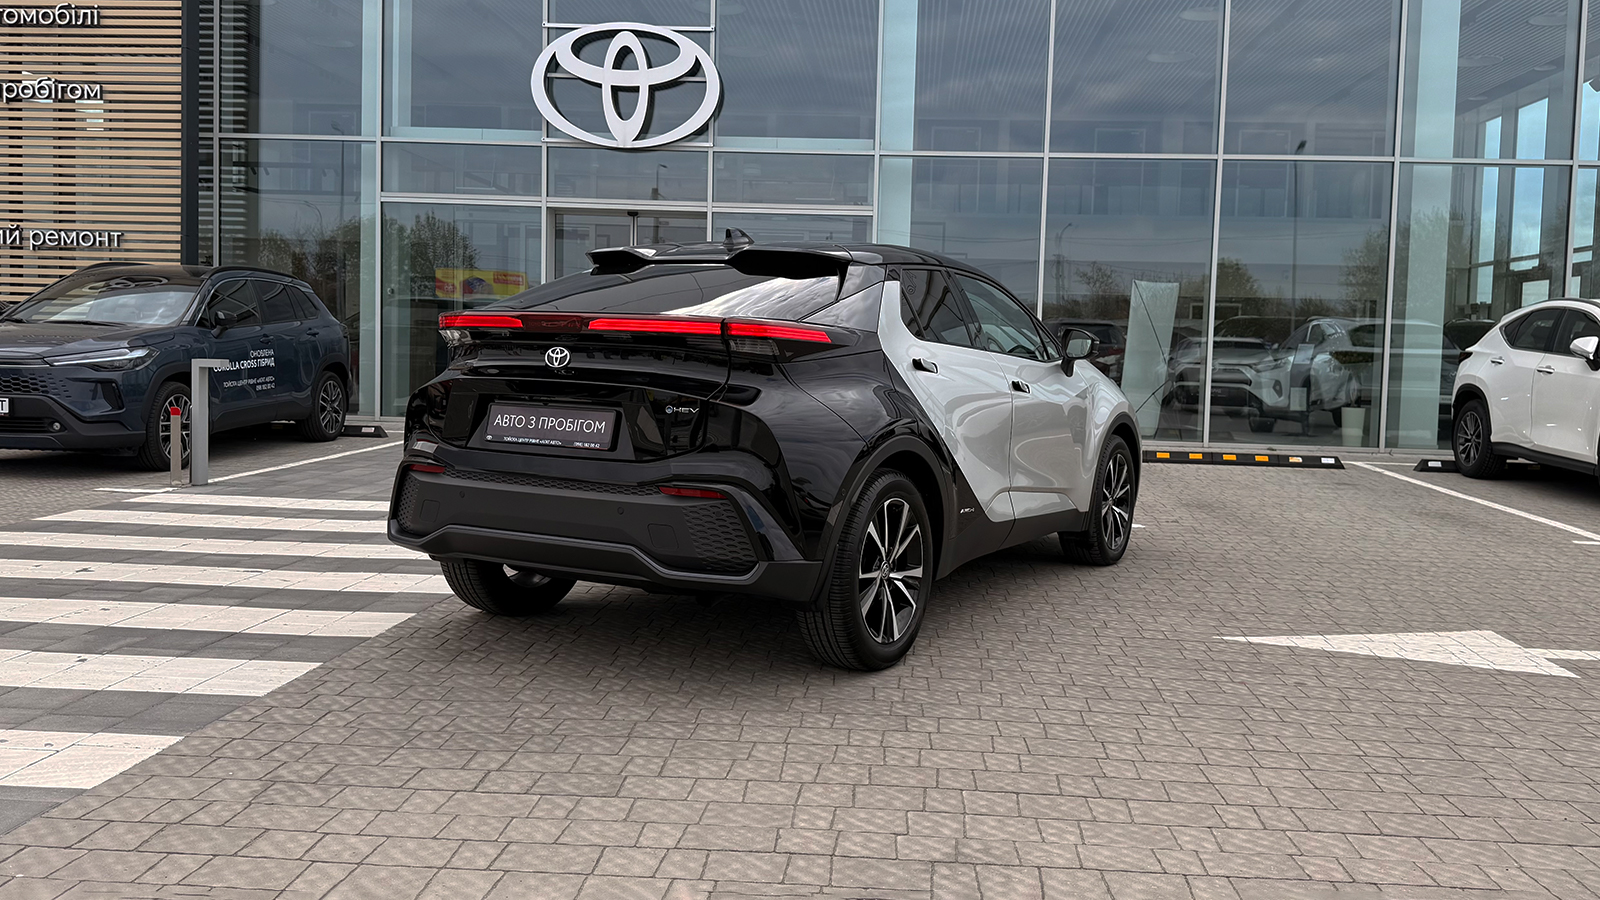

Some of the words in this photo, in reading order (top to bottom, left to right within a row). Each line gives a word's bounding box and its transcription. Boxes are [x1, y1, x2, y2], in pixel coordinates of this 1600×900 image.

[0, 3, 98, 25] омобілі
[29, 230, 122, 251] ремонт
[240, 359, 257, 369] CROSS
[493, 414, 525, 428] АВТО
[527, 416, 536, 429] З
[538, 416, 606, 434] ПРОБІГОМ
